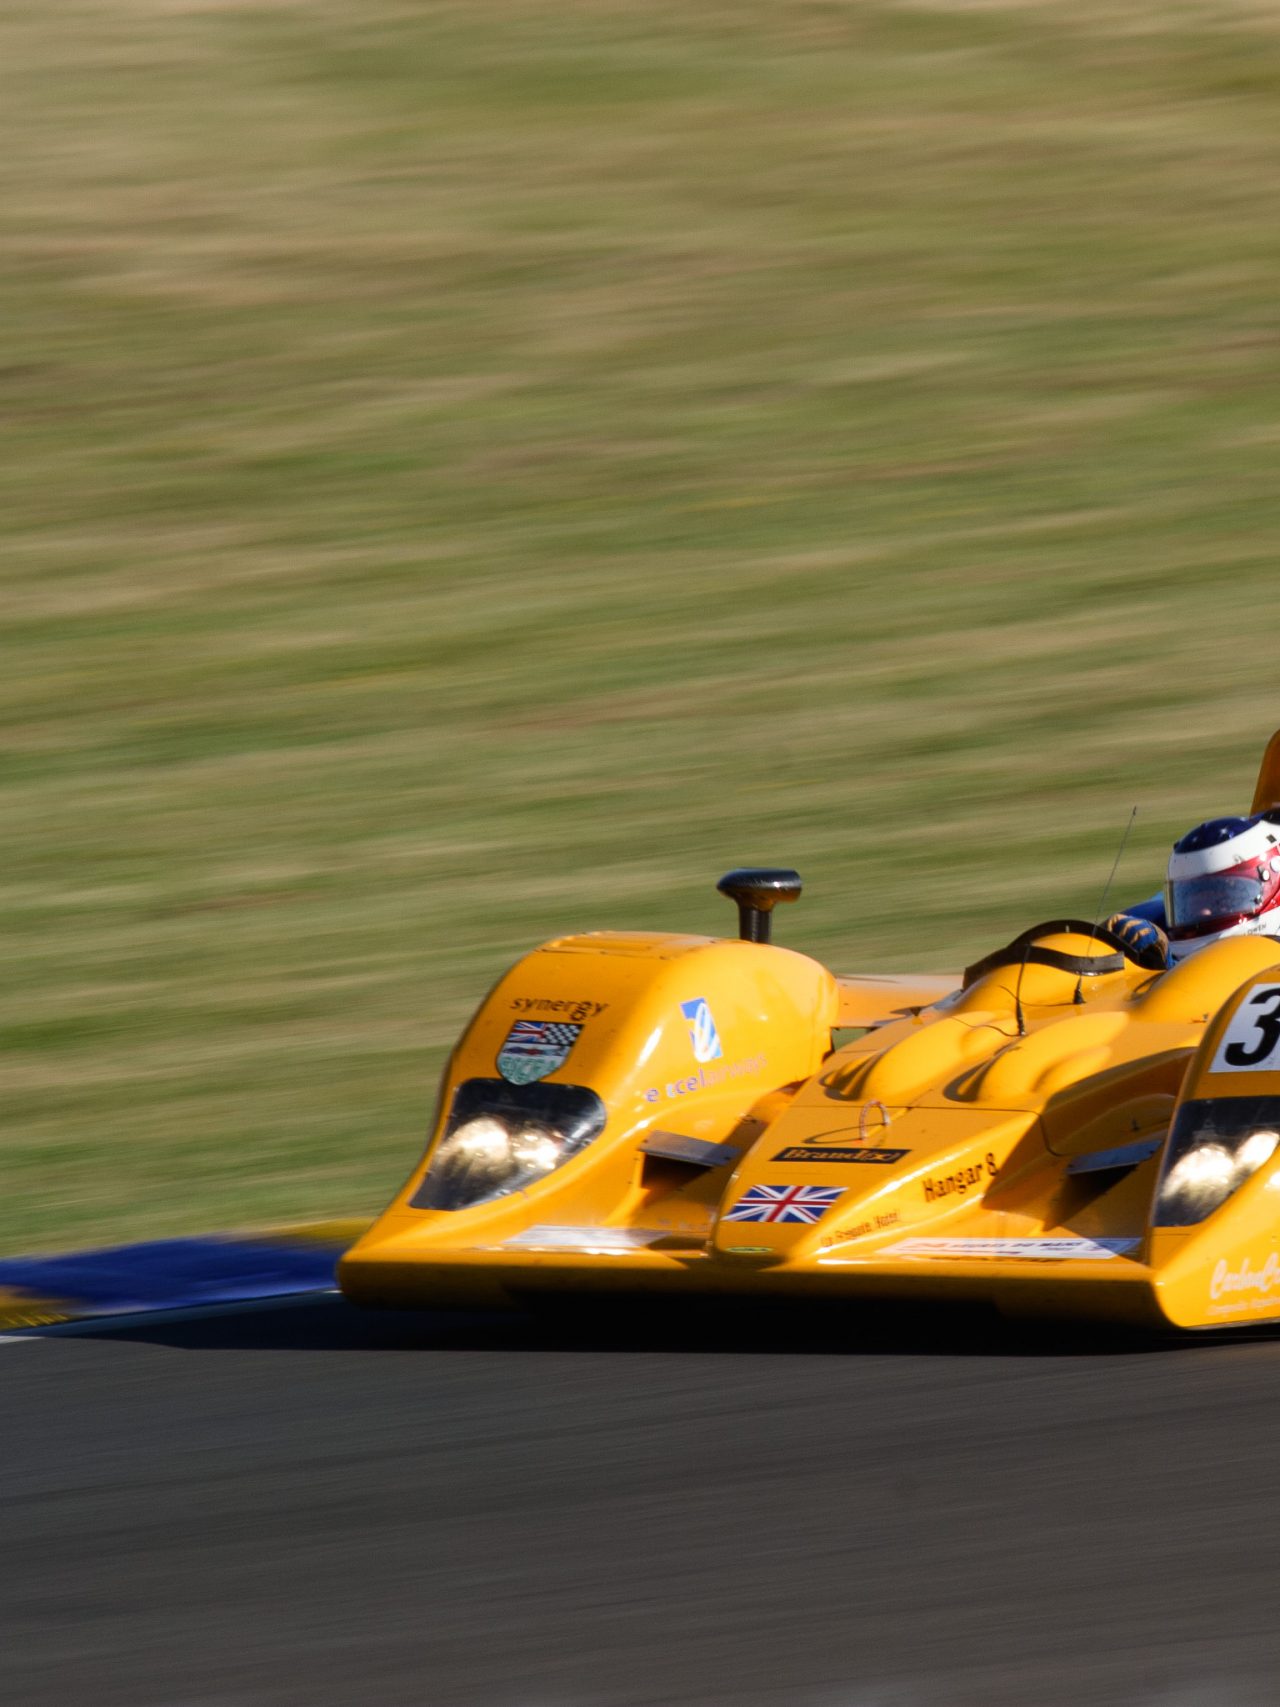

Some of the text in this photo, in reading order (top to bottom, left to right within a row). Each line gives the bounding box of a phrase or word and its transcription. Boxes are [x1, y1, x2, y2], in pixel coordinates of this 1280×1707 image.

[510, 998, 610, 1021] synergy
[922, 1152, 999, 1203] Hangar 8
